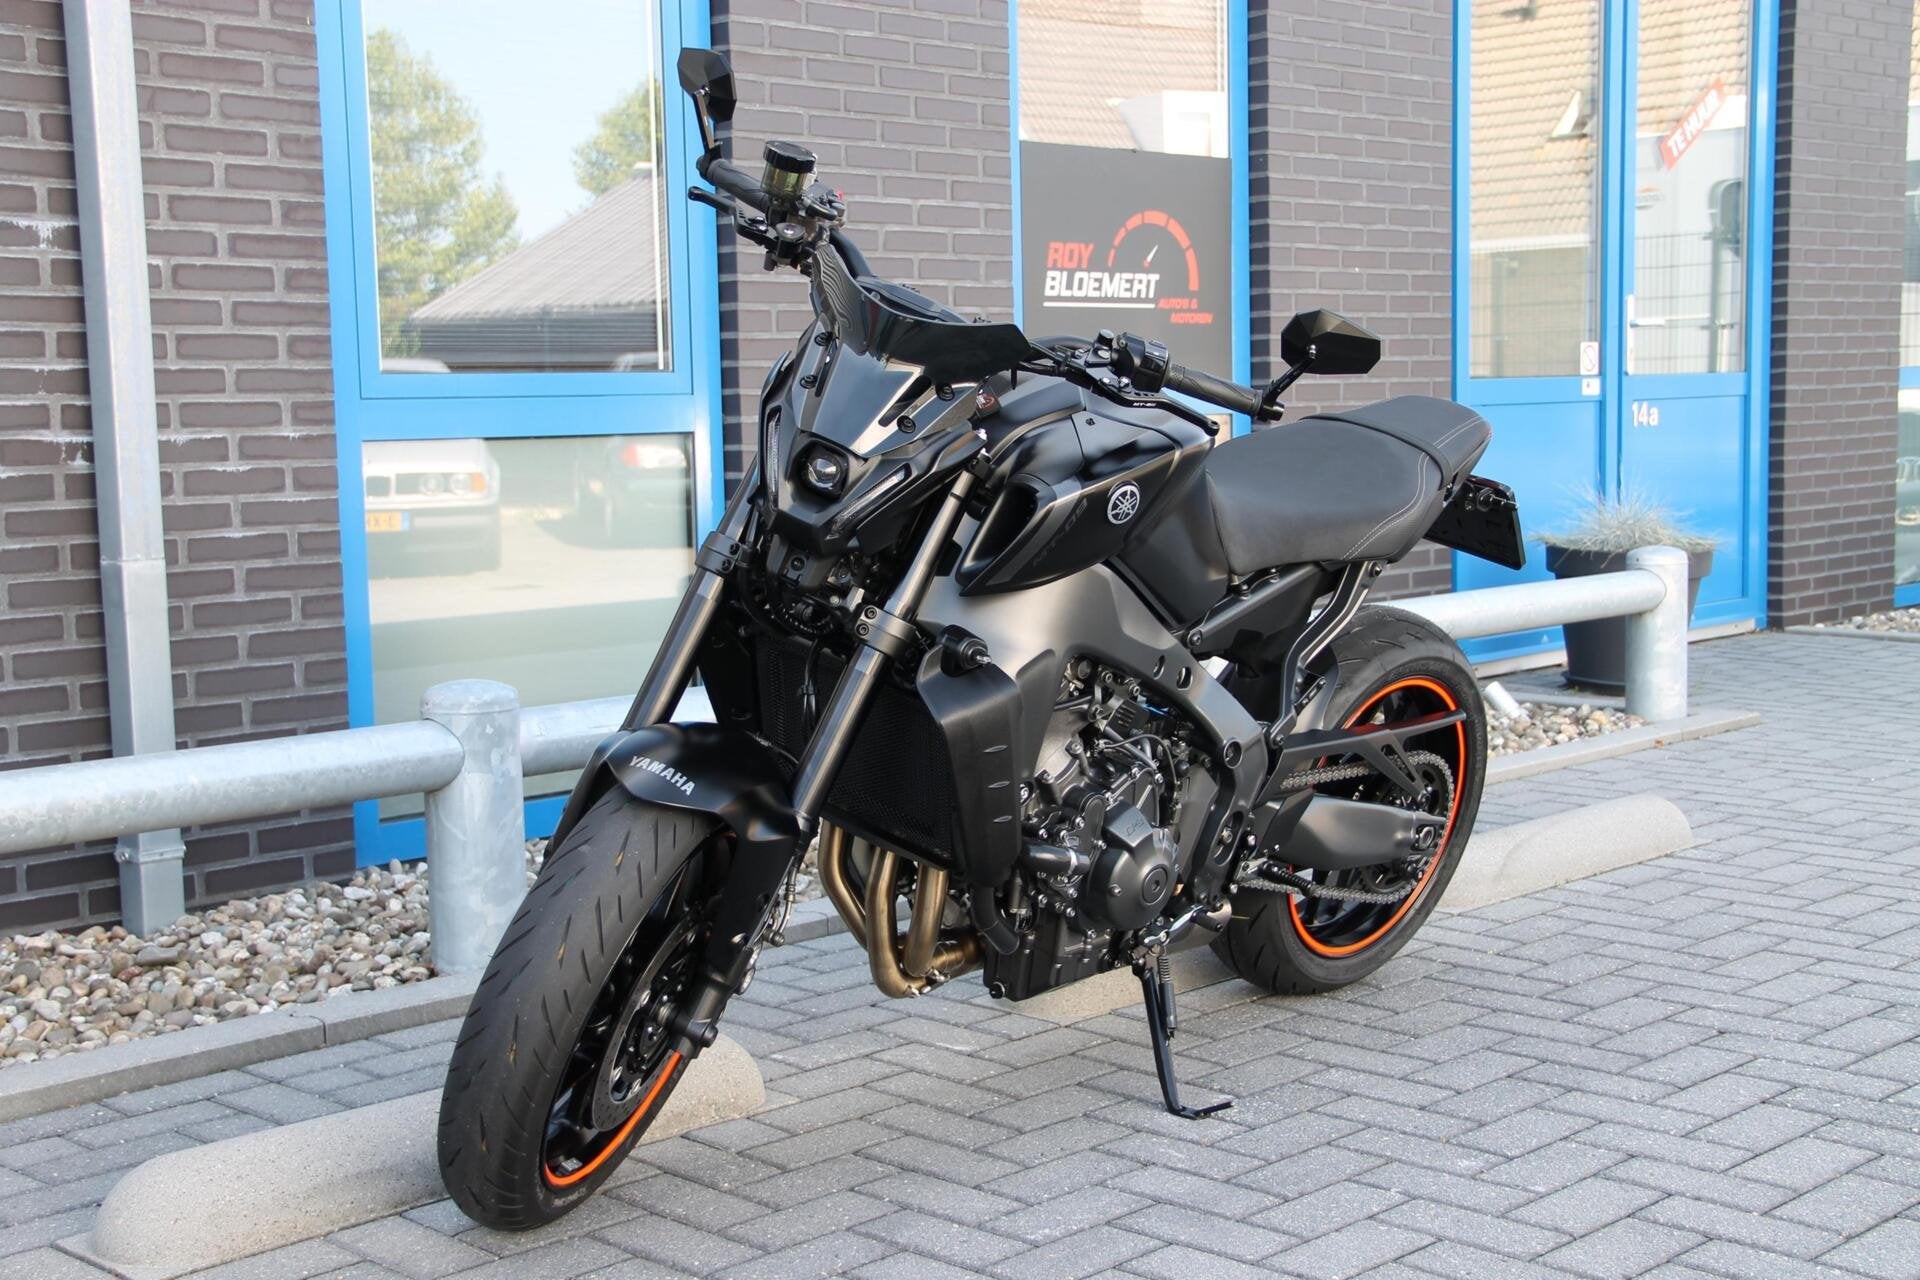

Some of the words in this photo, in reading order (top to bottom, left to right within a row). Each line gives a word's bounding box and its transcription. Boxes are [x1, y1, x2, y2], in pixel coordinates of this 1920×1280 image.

[1046, 241, 1094, 269] ROY
[1044, 271, 1160, 299] BLOEMERT
[1632, 401, 1659, 428] 14a
[629, 755, 696, 796] YAMAHA
